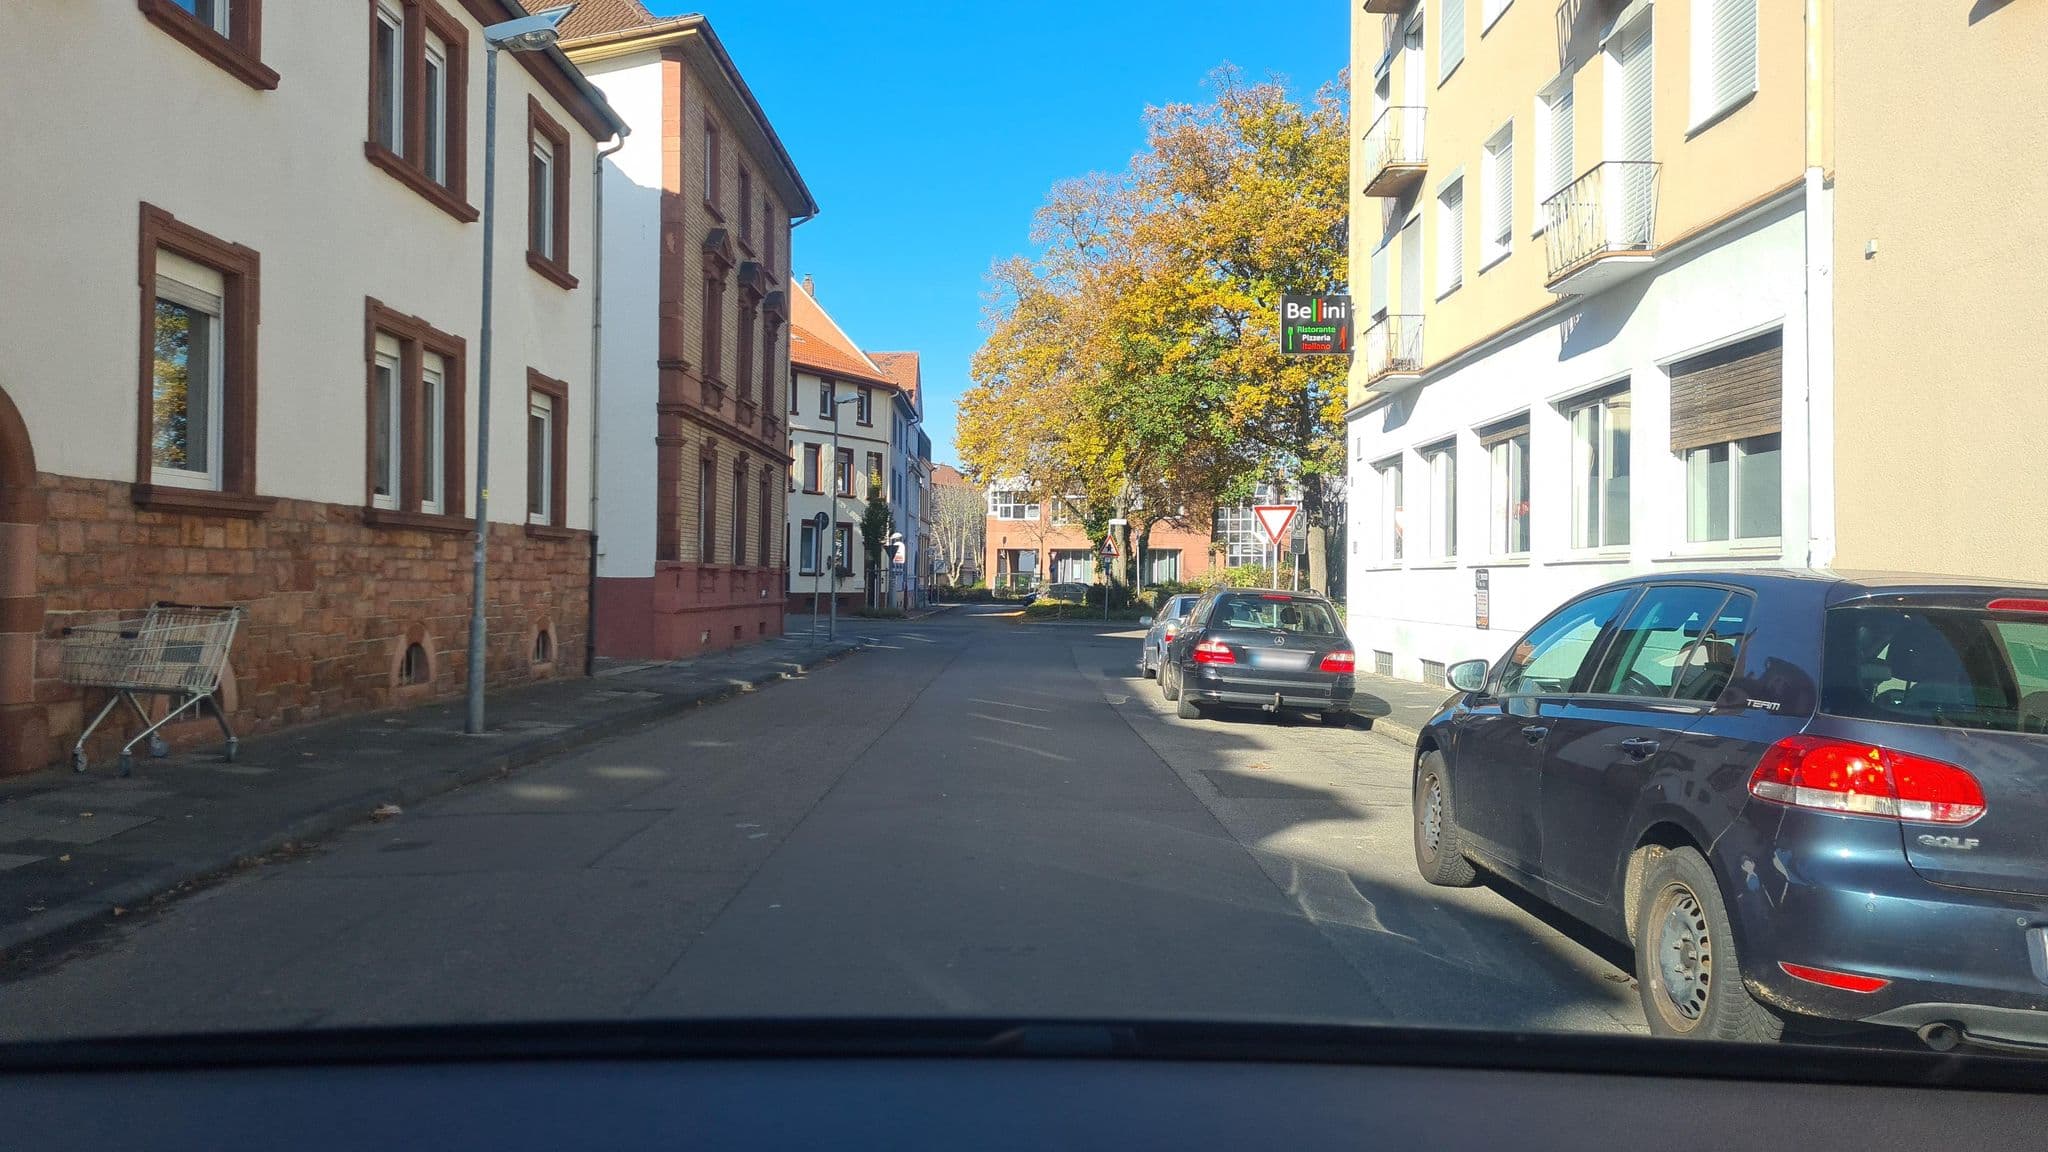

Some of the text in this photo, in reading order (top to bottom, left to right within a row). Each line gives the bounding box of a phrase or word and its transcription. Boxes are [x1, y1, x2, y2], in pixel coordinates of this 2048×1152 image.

[1287, 298, 1346, 323] Bellini
[1297, 325, 1336, 333] Ristorante
[1746, 698, 1781, 711] TEAM
[1917, 834, 1980, 850] GOLF
